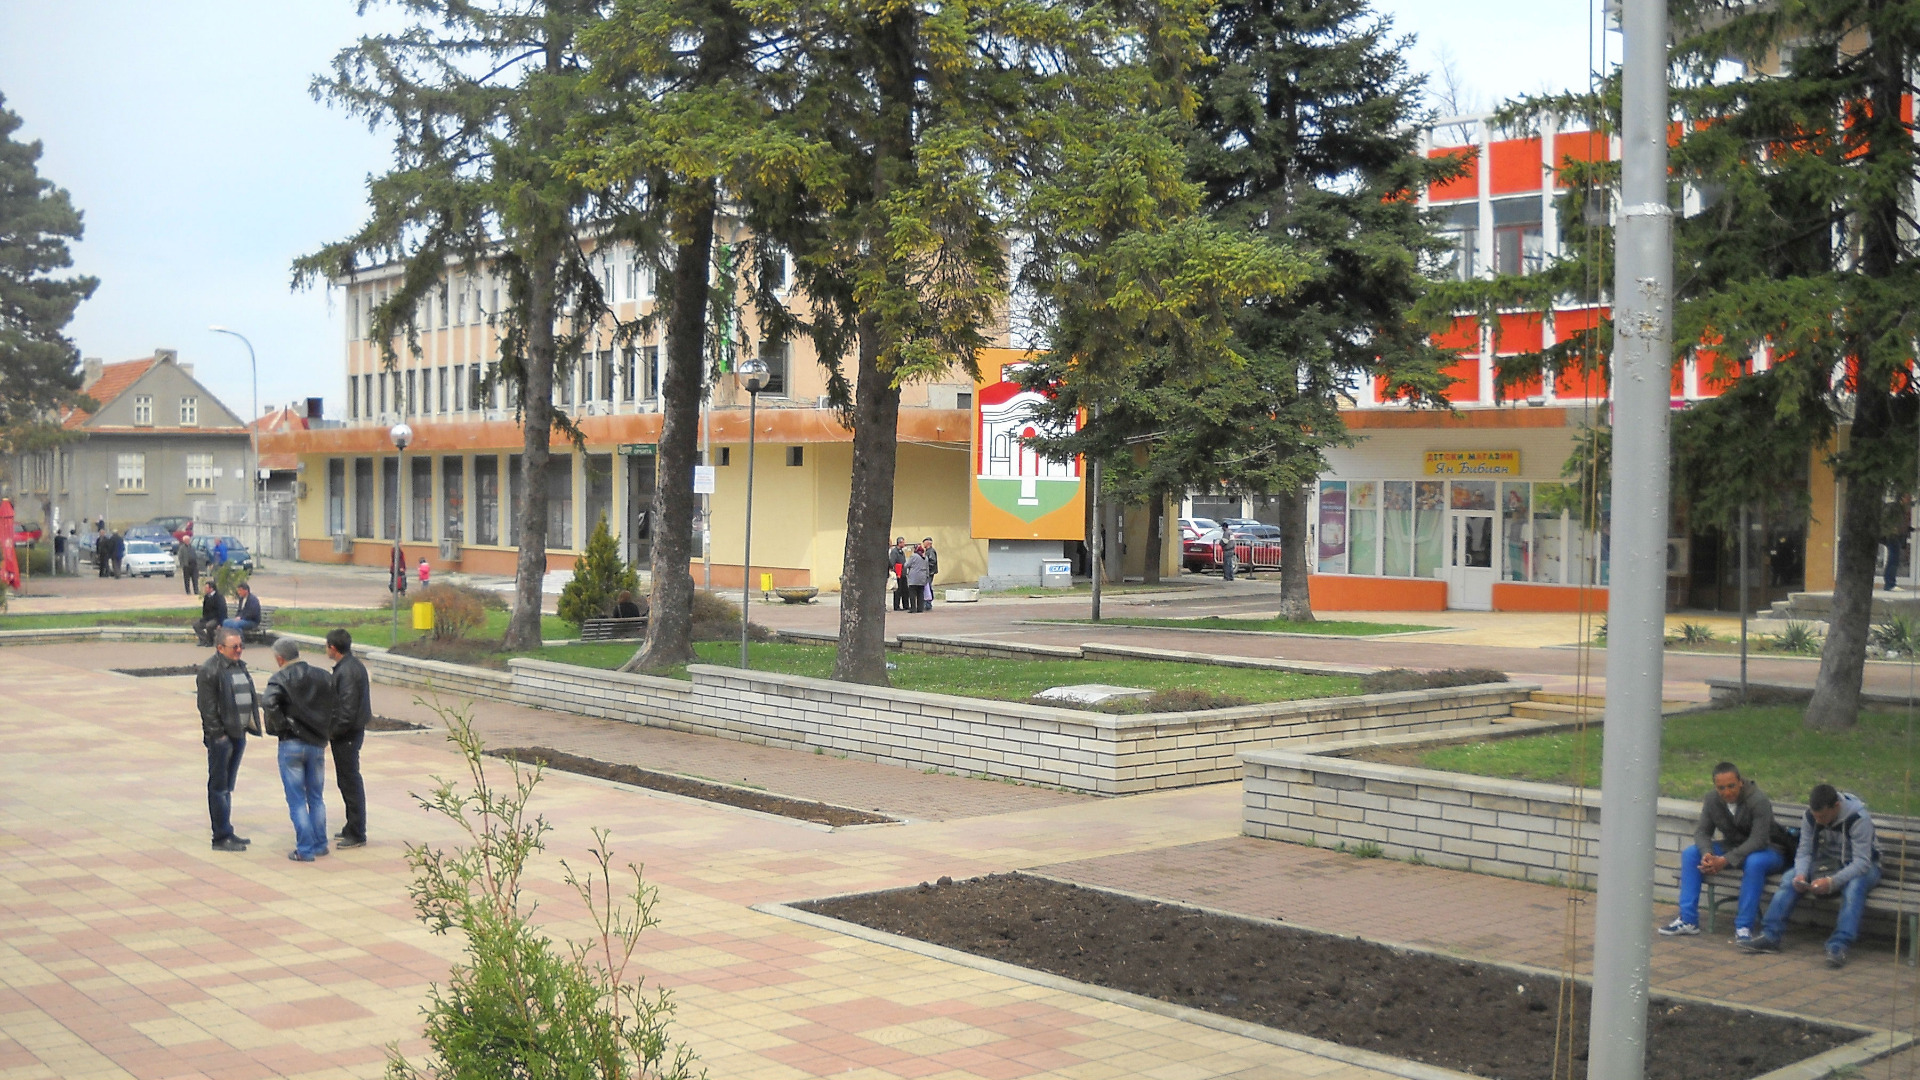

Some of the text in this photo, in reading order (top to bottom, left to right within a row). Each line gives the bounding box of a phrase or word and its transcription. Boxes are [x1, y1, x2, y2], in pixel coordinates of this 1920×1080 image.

[1427, 453, 1464, 462] ДЕТСКИ
[1435, 462, 1509, 474] Ян Бибиян
